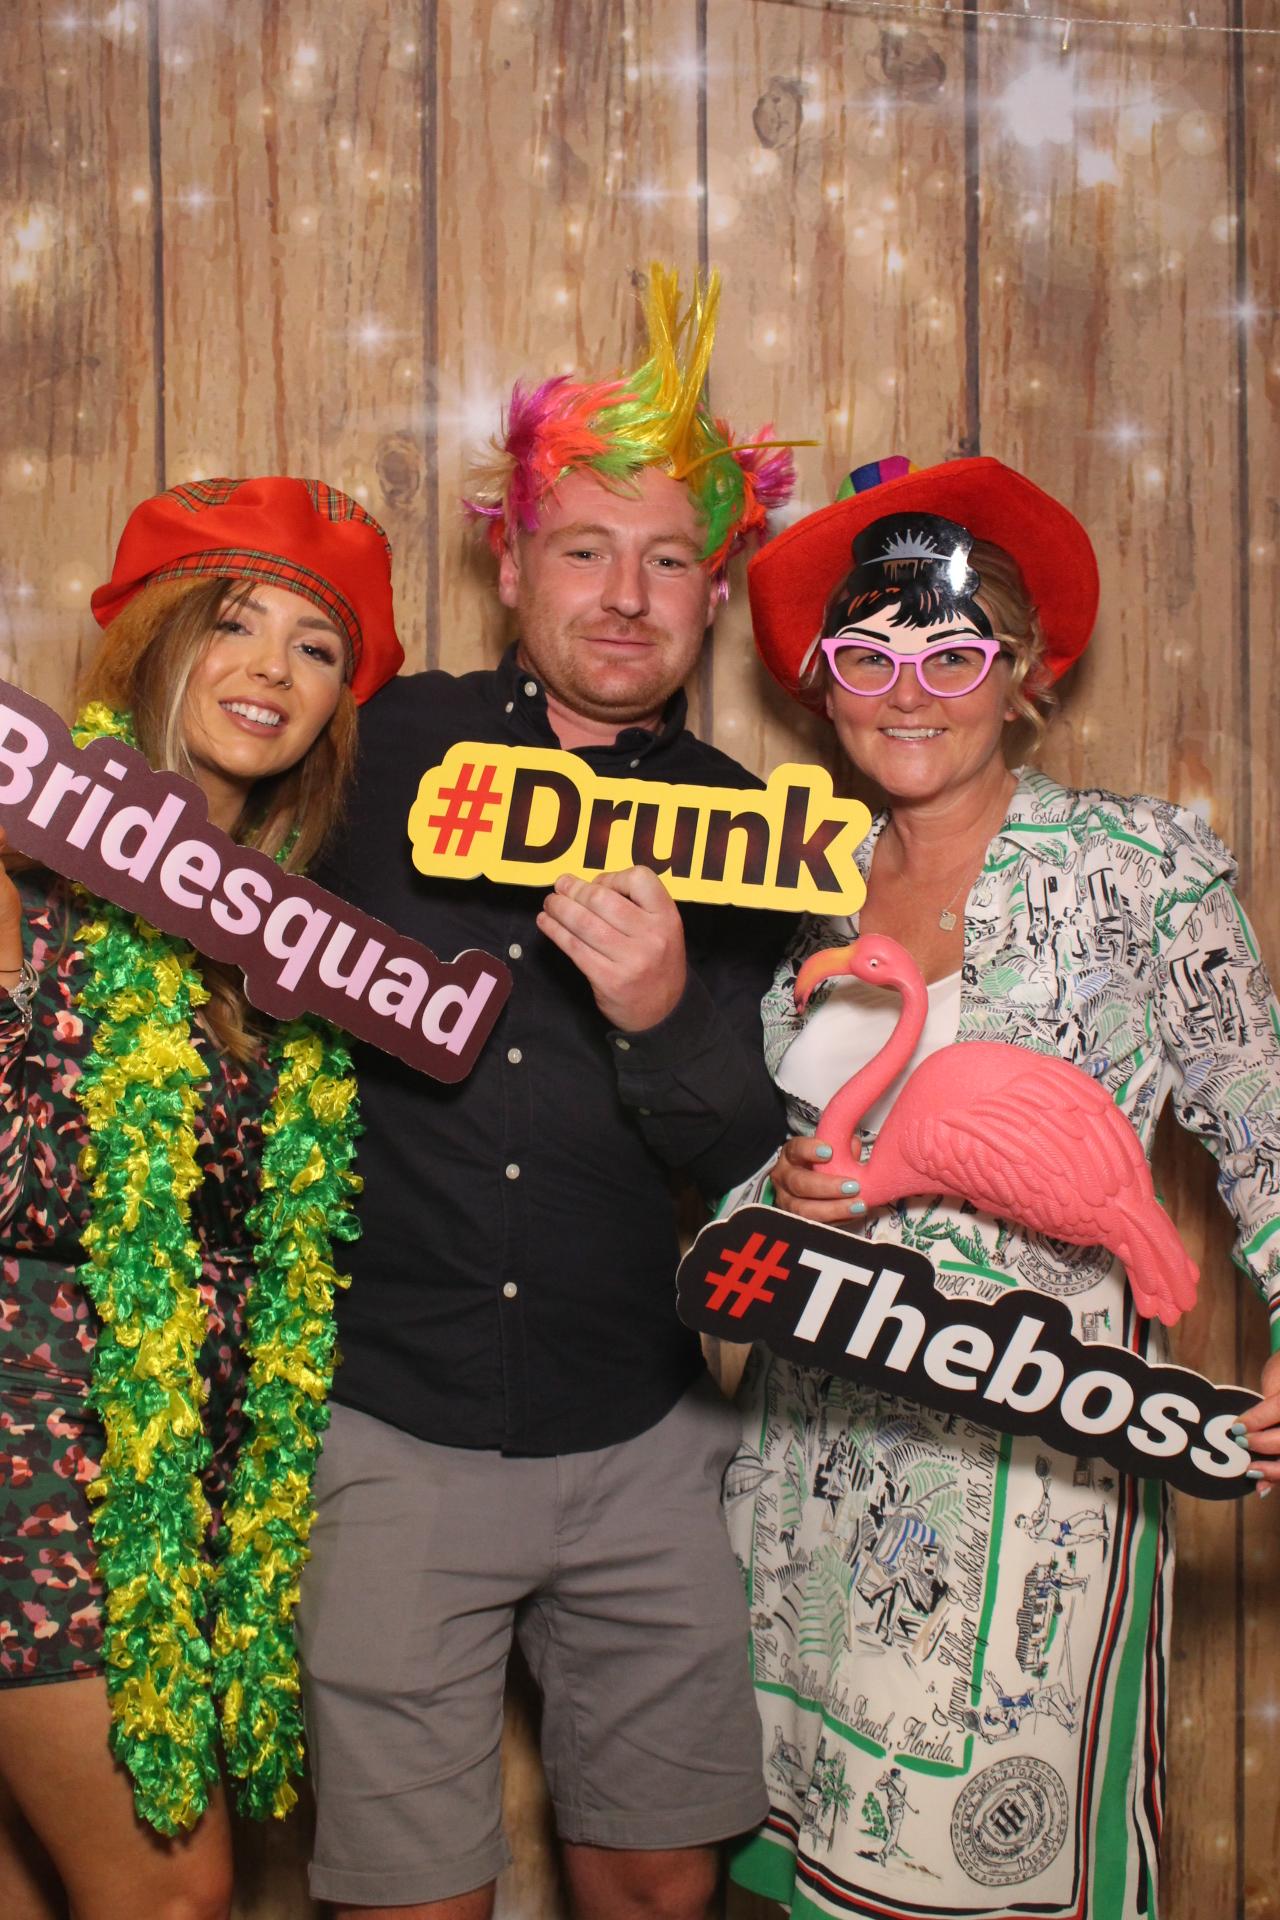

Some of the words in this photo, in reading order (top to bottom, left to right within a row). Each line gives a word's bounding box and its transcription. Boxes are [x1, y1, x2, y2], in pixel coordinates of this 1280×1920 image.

[428, 763, 849, 893] #Drunk
[0, 704, 498, 1056] Bridesquad
[705, 1232, 1252, 1479] #Theboss
[960, 1441, 1009, 1480] Key
[965, 1478, 994, 1523] 1985.
[945, 1519, 989, 1613] Established
[937, 1614, 989, 1676] Hilfiger
[932, 1676, 983, 1734] Tommy
[896, 1716, 955, 1764] Florida.
